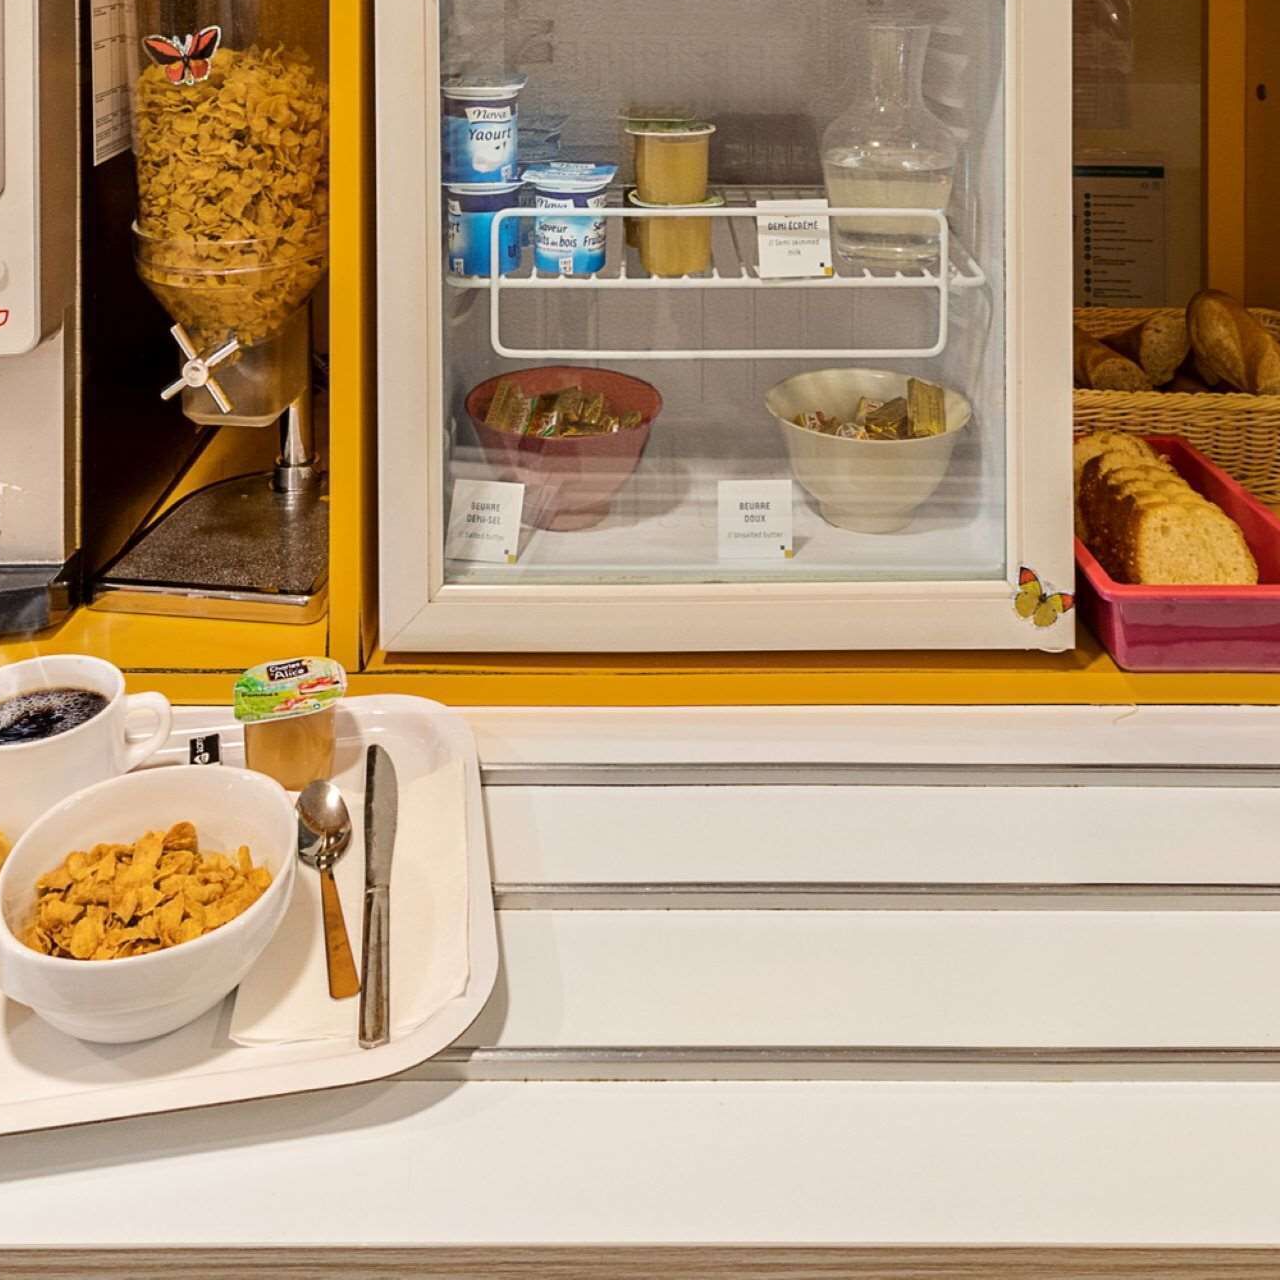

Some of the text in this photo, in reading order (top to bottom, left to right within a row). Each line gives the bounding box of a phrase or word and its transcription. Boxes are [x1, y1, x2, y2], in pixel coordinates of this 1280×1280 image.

[468, 127, 513, 142] Yaourt
[767, 222, 786, 231] DEMI
[559, 235, 578, 248] bois
[739, 502, 771, 511] BEURRE
[744, 514, 766, 523] DOUX
[270, 661, 303, 674] Charles
[275, 667, 306, 681] Alice
